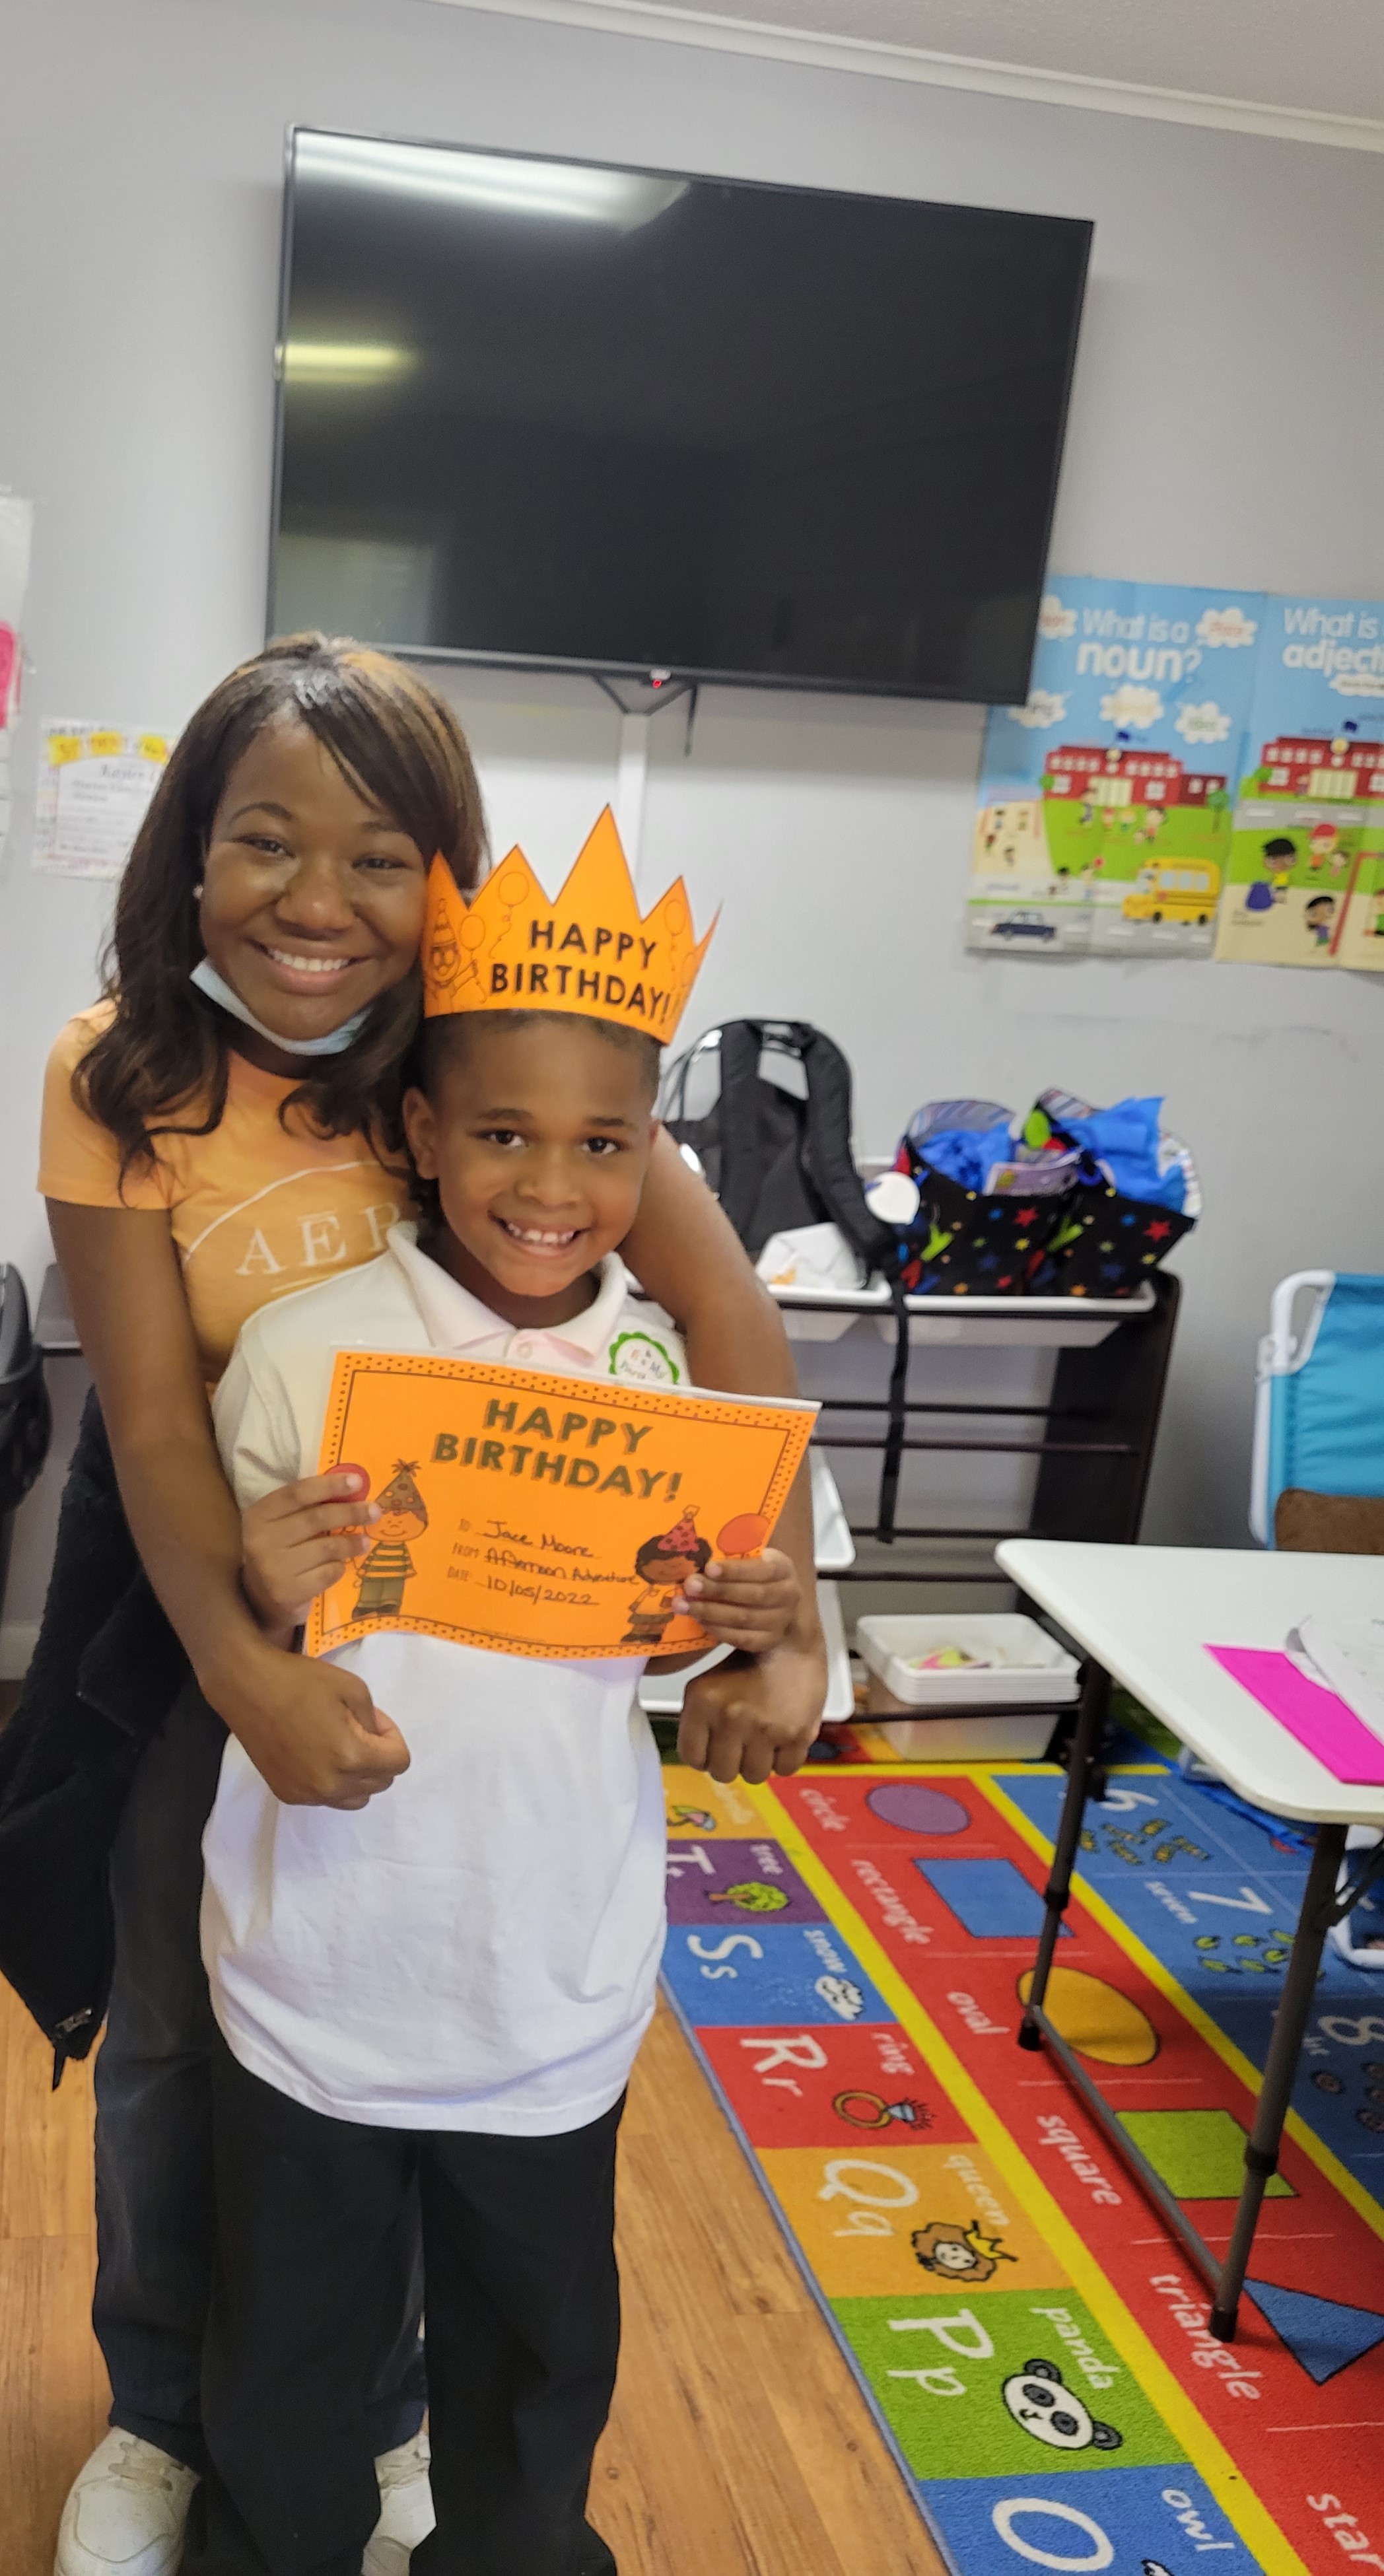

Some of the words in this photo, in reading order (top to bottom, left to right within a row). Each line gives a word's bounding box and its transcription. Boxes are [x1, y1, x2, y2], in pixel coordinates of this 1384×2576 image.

[1083, 608, 1146, 640] What
[1147, 613, 1170, 643] is
[1284, 608, 1354, 638] What
[1357, 611, 1379, 639] is
[1076, 643, 1202, 683] noun?
[530, 919, 658, 970] HAPPY
[489, 963, 672, 1024] BIRTHDAY!
[483, 1398, 653, 1454] HAPPY
[430, 1432, 683, 1503] BIRTHDAY!
[540, 1533, 594, 1558] Moore
[486, 1576, 598, 1605] 10/05/2022
[851, 1859, 934, 1945] rectangle
[804, 1930, 848, 1974] snow
[947, 1991, 1010, 2035] oval
[872, 2032, 915, 2075] ring
[1037, 2115, 1121, 2206] square
[943, 2155, 1011, 2227] queen
[1029, 2307, 1121, 2390] panda
[1150, 2274, 1263, 2400] triangle
[992, 2497, 1115, 2572] O
[1162, 2488, 1235, 2552] owl
[1307, 2493, 1384, 2572] star
